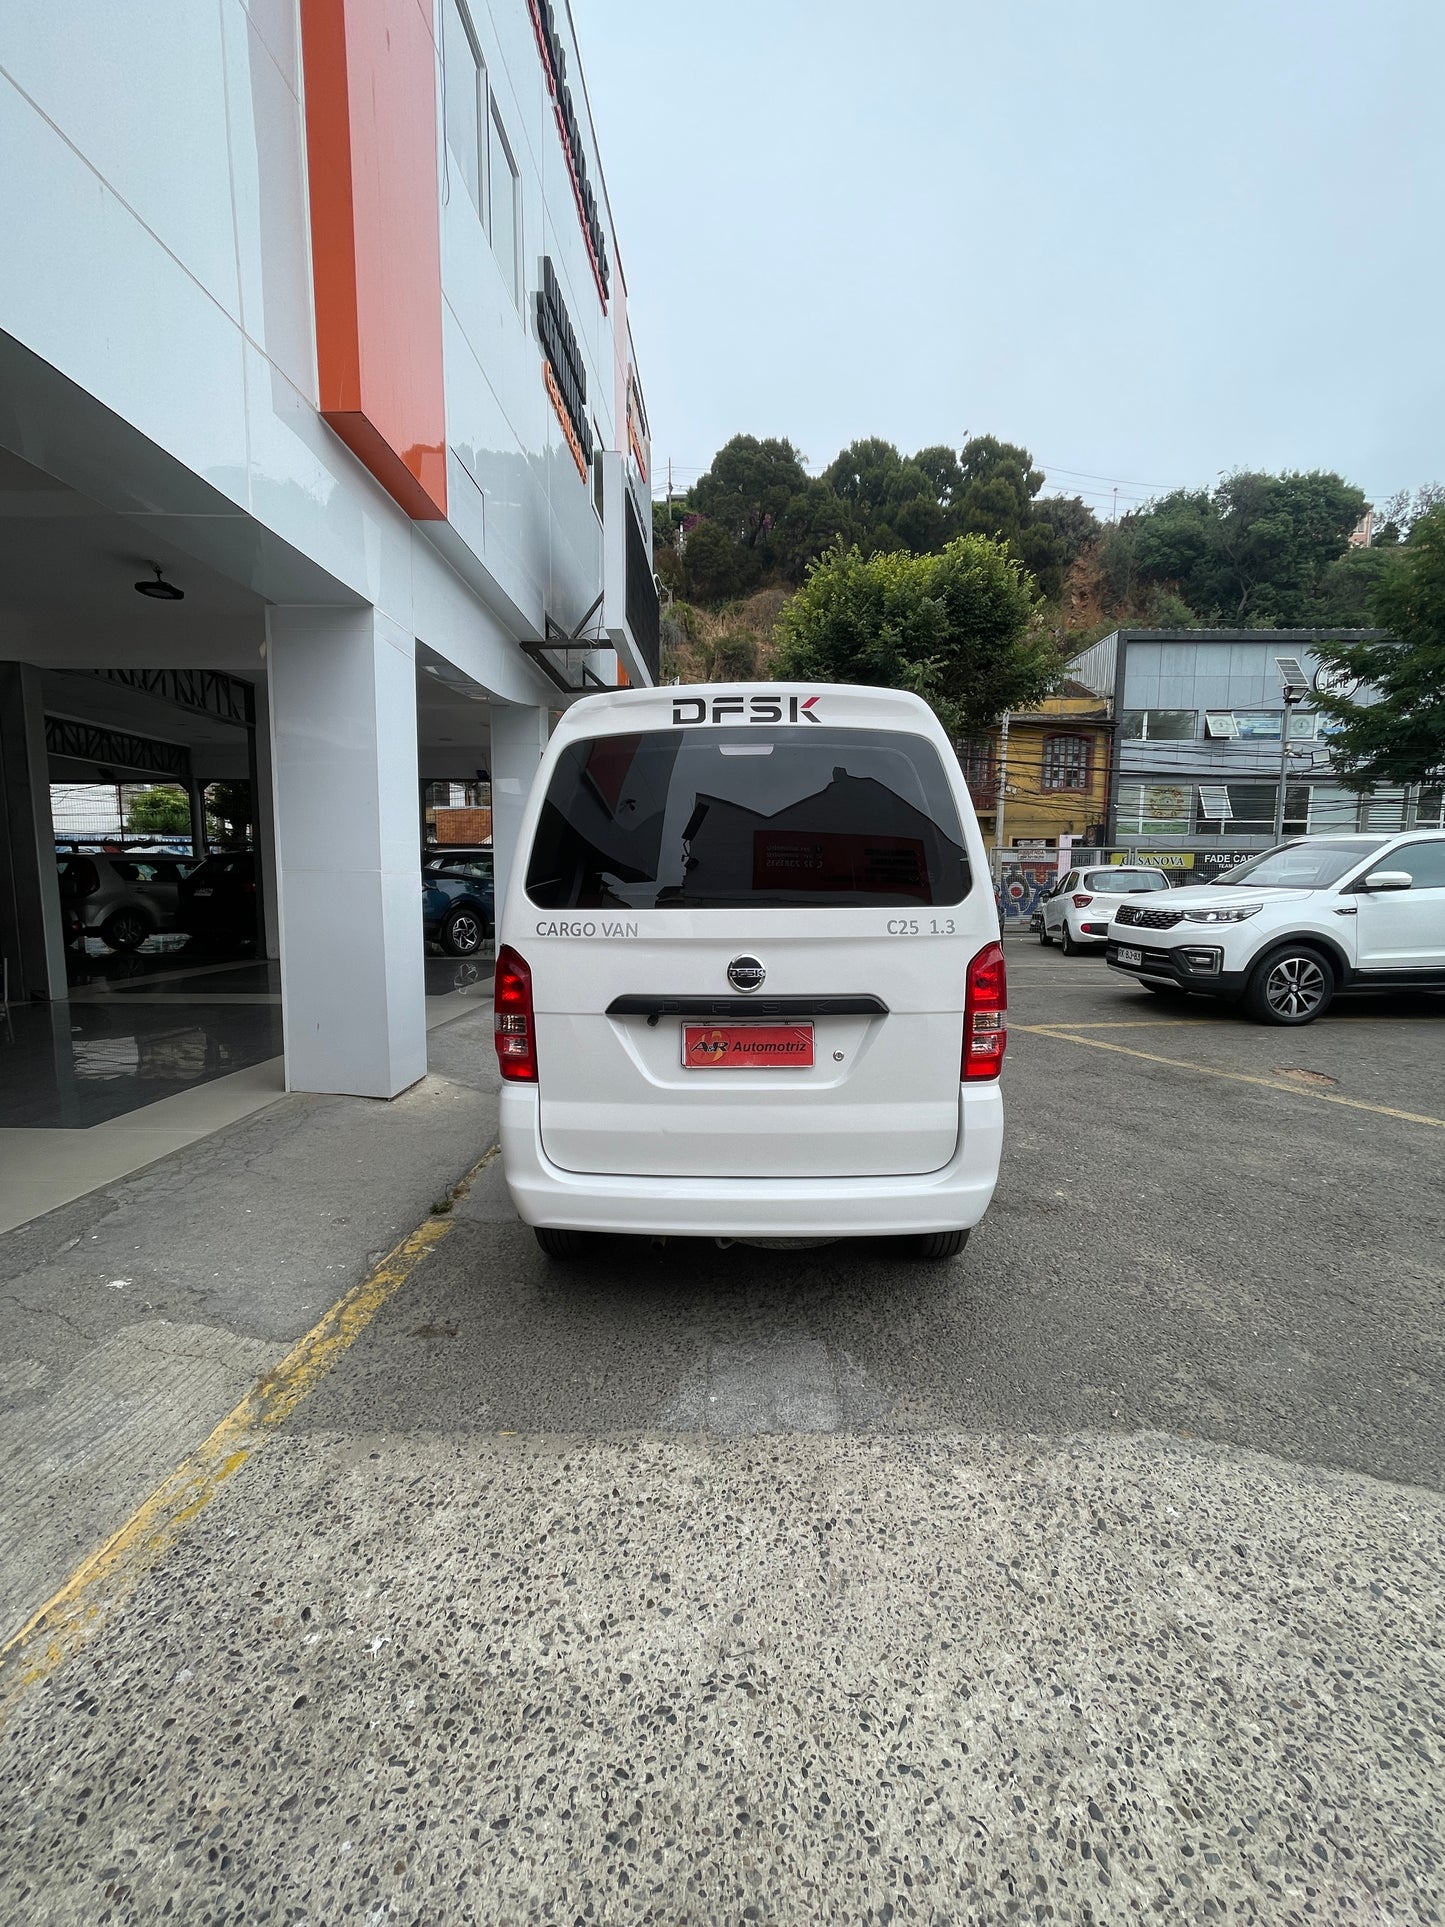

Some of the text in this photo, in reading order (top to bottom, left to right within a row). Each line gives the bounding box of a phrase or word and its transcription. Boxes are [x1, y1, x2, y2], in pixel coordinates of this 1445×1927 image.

[673, 697, 821, 724] DFSK
[1204, 854, 1231, 863] FADE
[536, 922, 639, 938] CARGO VAN
[886, 920, 956, 936] C25 1.3
[728, 967, 767, 979] DFSK
[656, 1001, 832, 1014] DFSK
[733, 1040, 807, 1053] Automotriz
